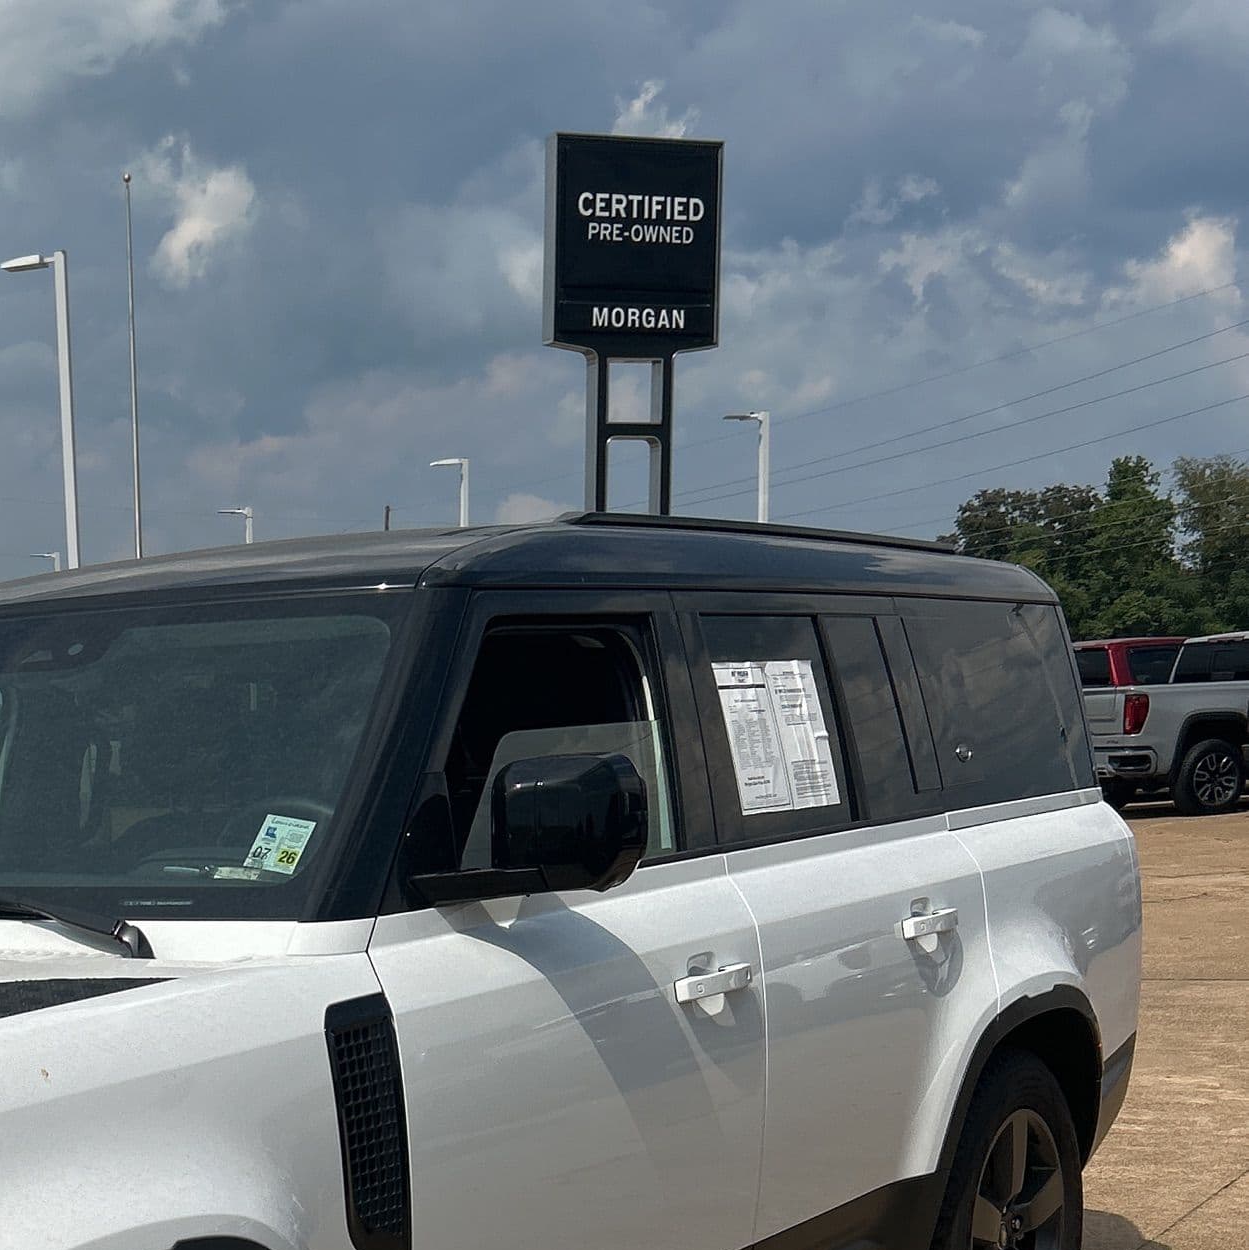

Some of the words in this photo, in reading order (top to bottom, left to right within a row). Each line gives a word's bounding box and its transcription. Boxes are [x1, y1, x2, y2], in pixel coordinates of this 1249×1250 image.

[578, 191, 705, 222] CERTIFIED
[587, 222, 694, 245] PRE-OWNED
[592, 307, 685, 329] MORGAN
[253, 846, 272, 860] 07
[278, 850, 297, 865] 26
